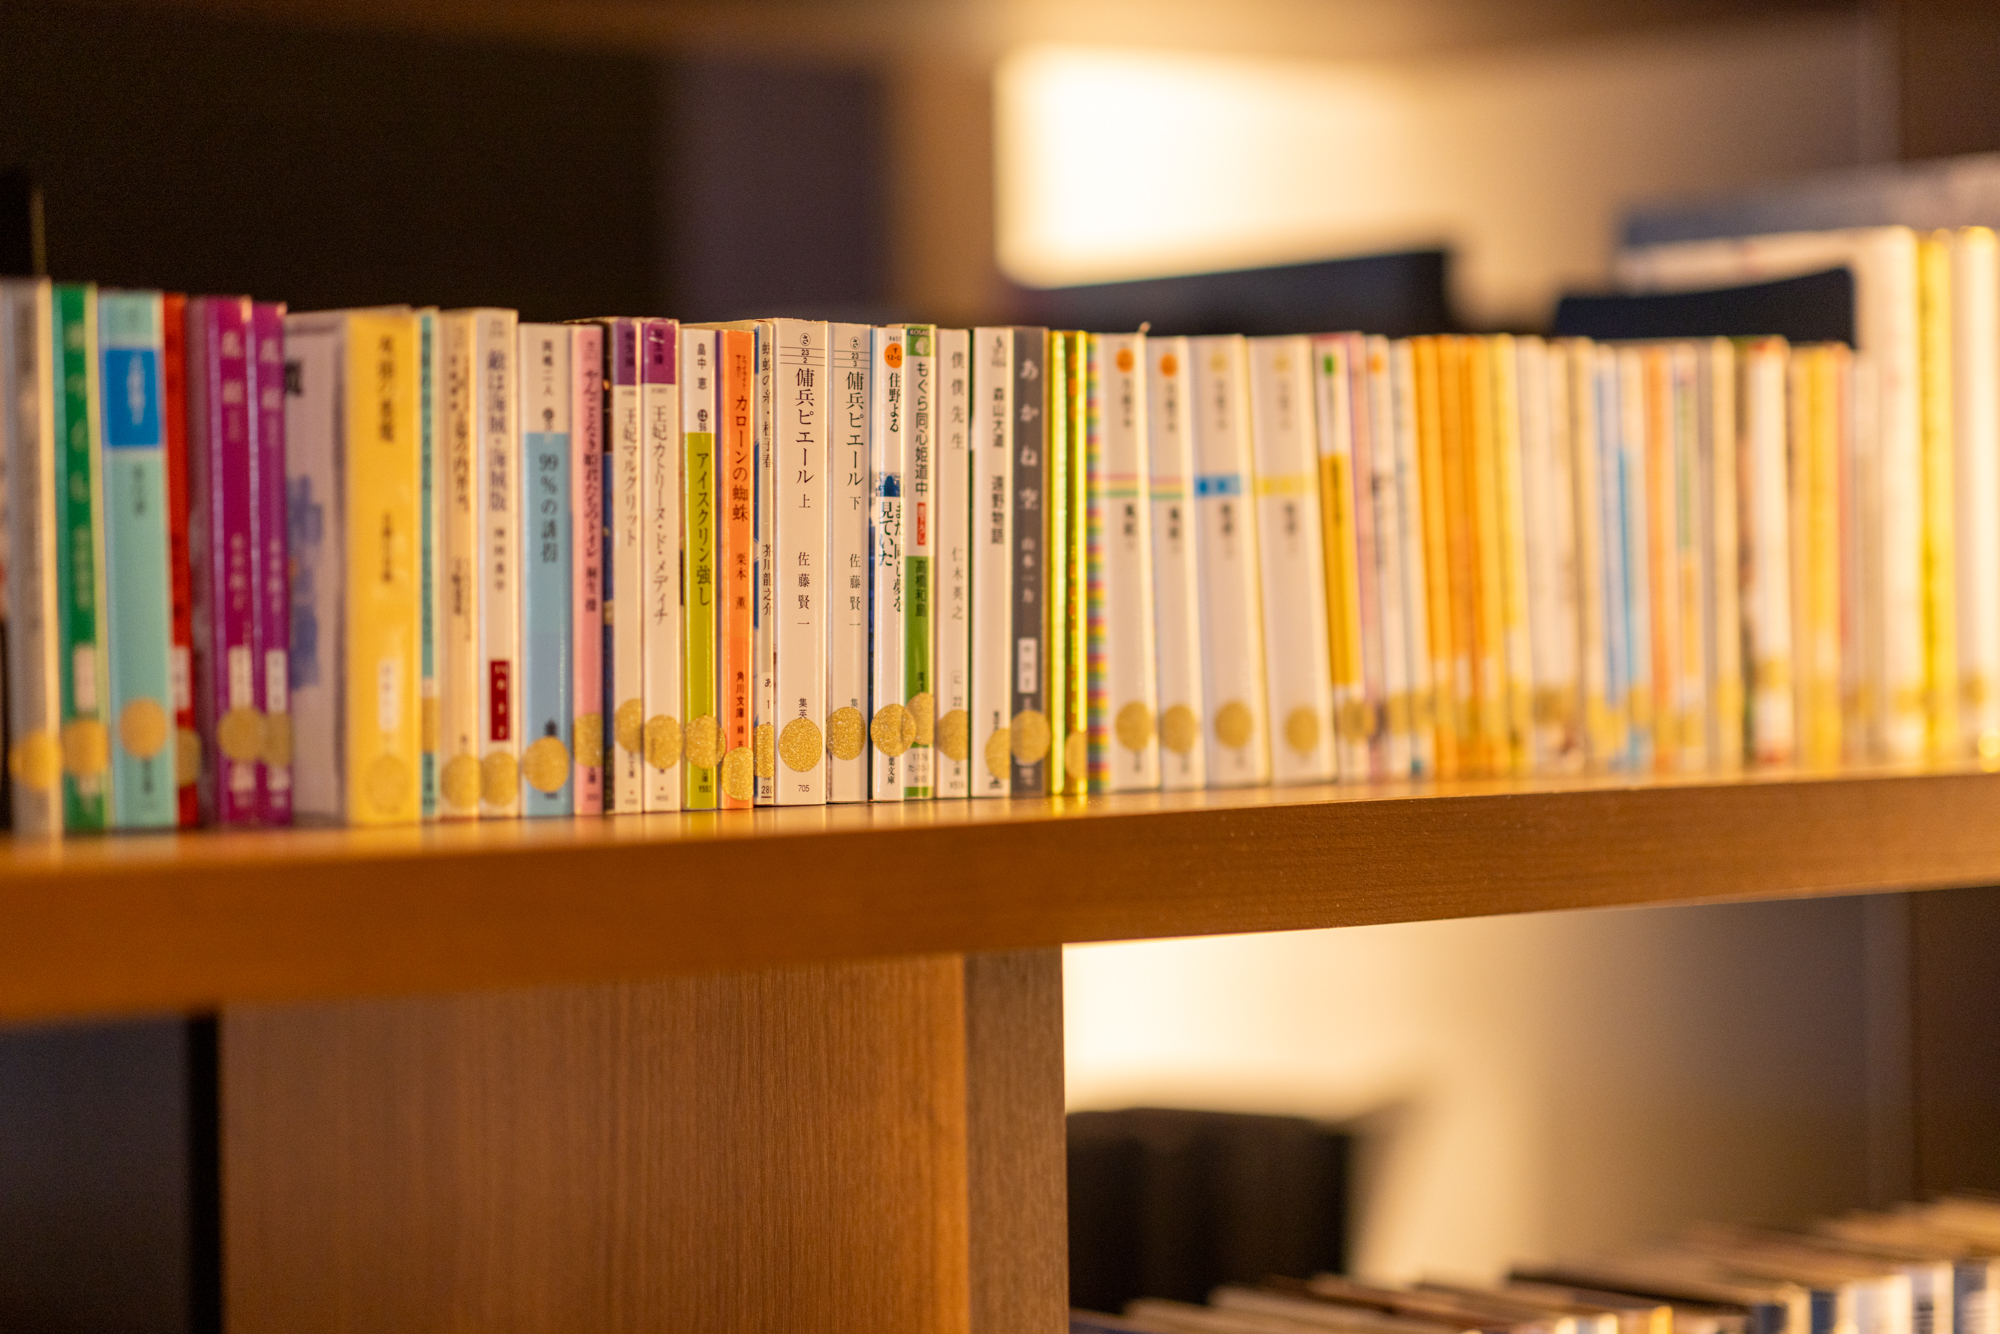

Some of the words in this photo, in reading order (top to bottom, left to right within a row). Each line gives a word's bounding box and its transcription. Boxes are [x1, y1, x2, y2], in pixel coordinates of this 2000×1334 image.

[795, 368, 814, 485] 傭兵ピエール
[845, 371, 864, 487] 傭兵ピエール
[889, 372, 901, 433] 住野よる
[915, 361, 929, 497] もぐら同心姫道中
[951, 352, 964, 450] 僕僕先生
[732, 395, 748, 522] カローンの蜘蛛
[696, 451, 711, 606] アイスクリン強し
[798, 494, 811, 509] 上
[849, 496, 862, 511] 下
[879, 501, 893, 567] 見ていた
[797, 551, 811, 625] 佐藤賢一
[849, 553, 861, 626] 佐藤賢一
[798, 784, 810, 792] 705
